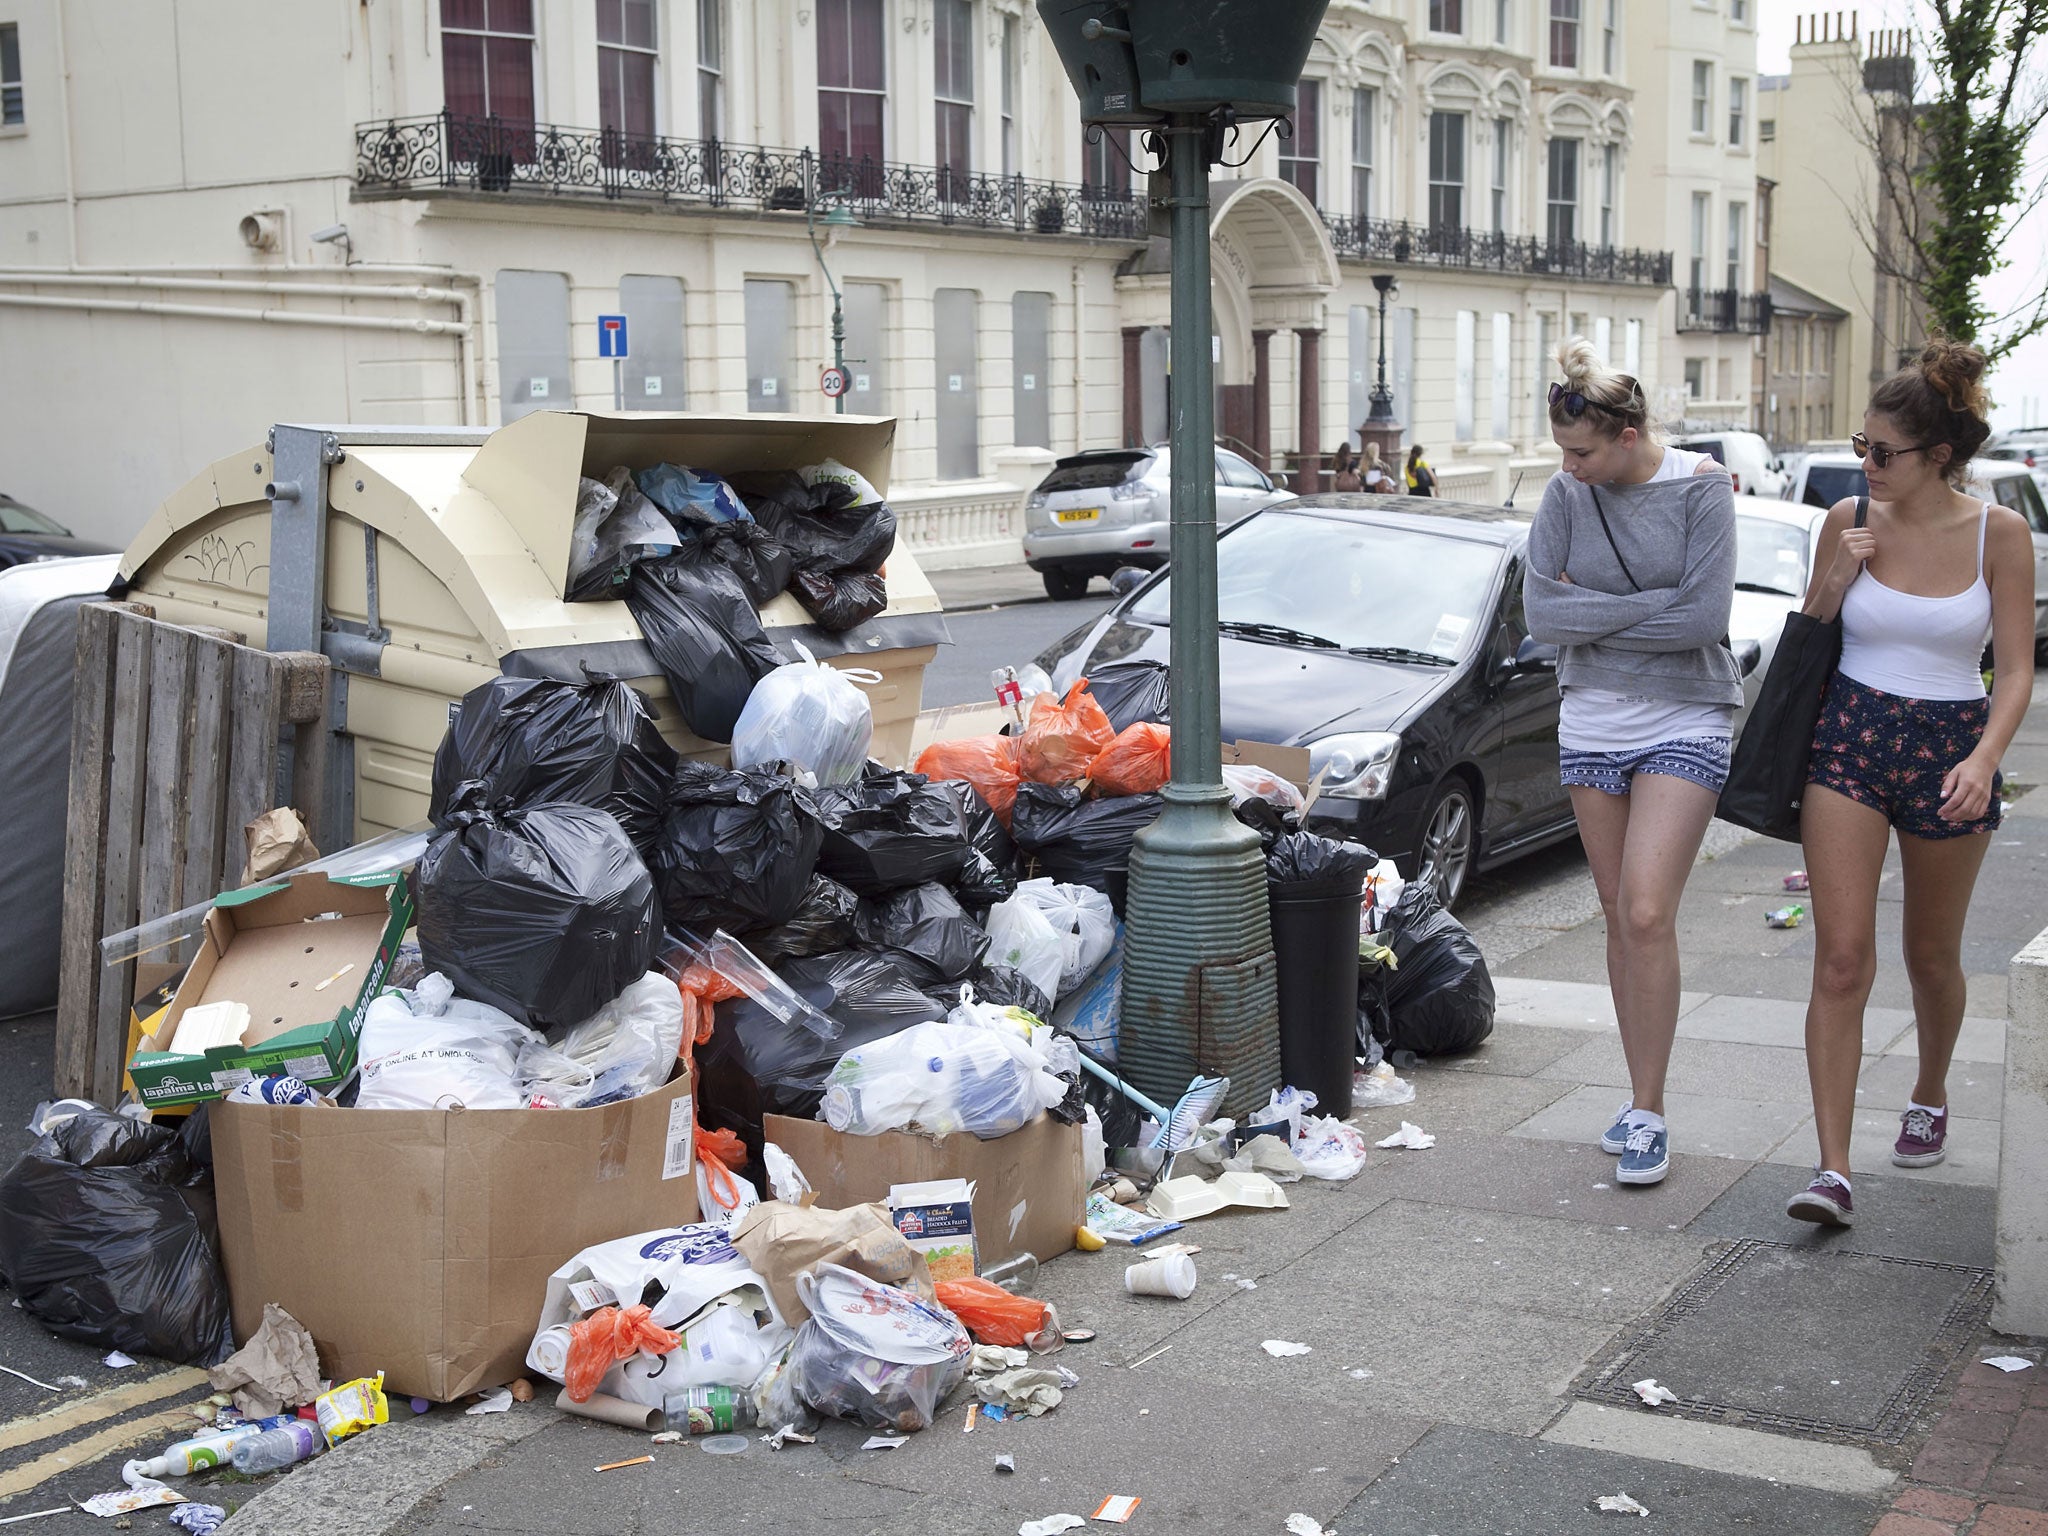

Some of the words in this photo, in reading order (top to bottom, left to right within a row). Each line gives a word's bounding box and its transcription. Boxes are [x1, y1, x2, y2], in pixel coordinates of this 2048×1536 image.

[825, 377, 841, 389] 20
[349, 872, 391, 883] laparcela
[347, 957, 385, 1039] laparcela
[384, 1052, 418, 1069] ONLINE
[421, 1050, 434, 1059] AT
[142, 1083, 196, 1098] lapalma
